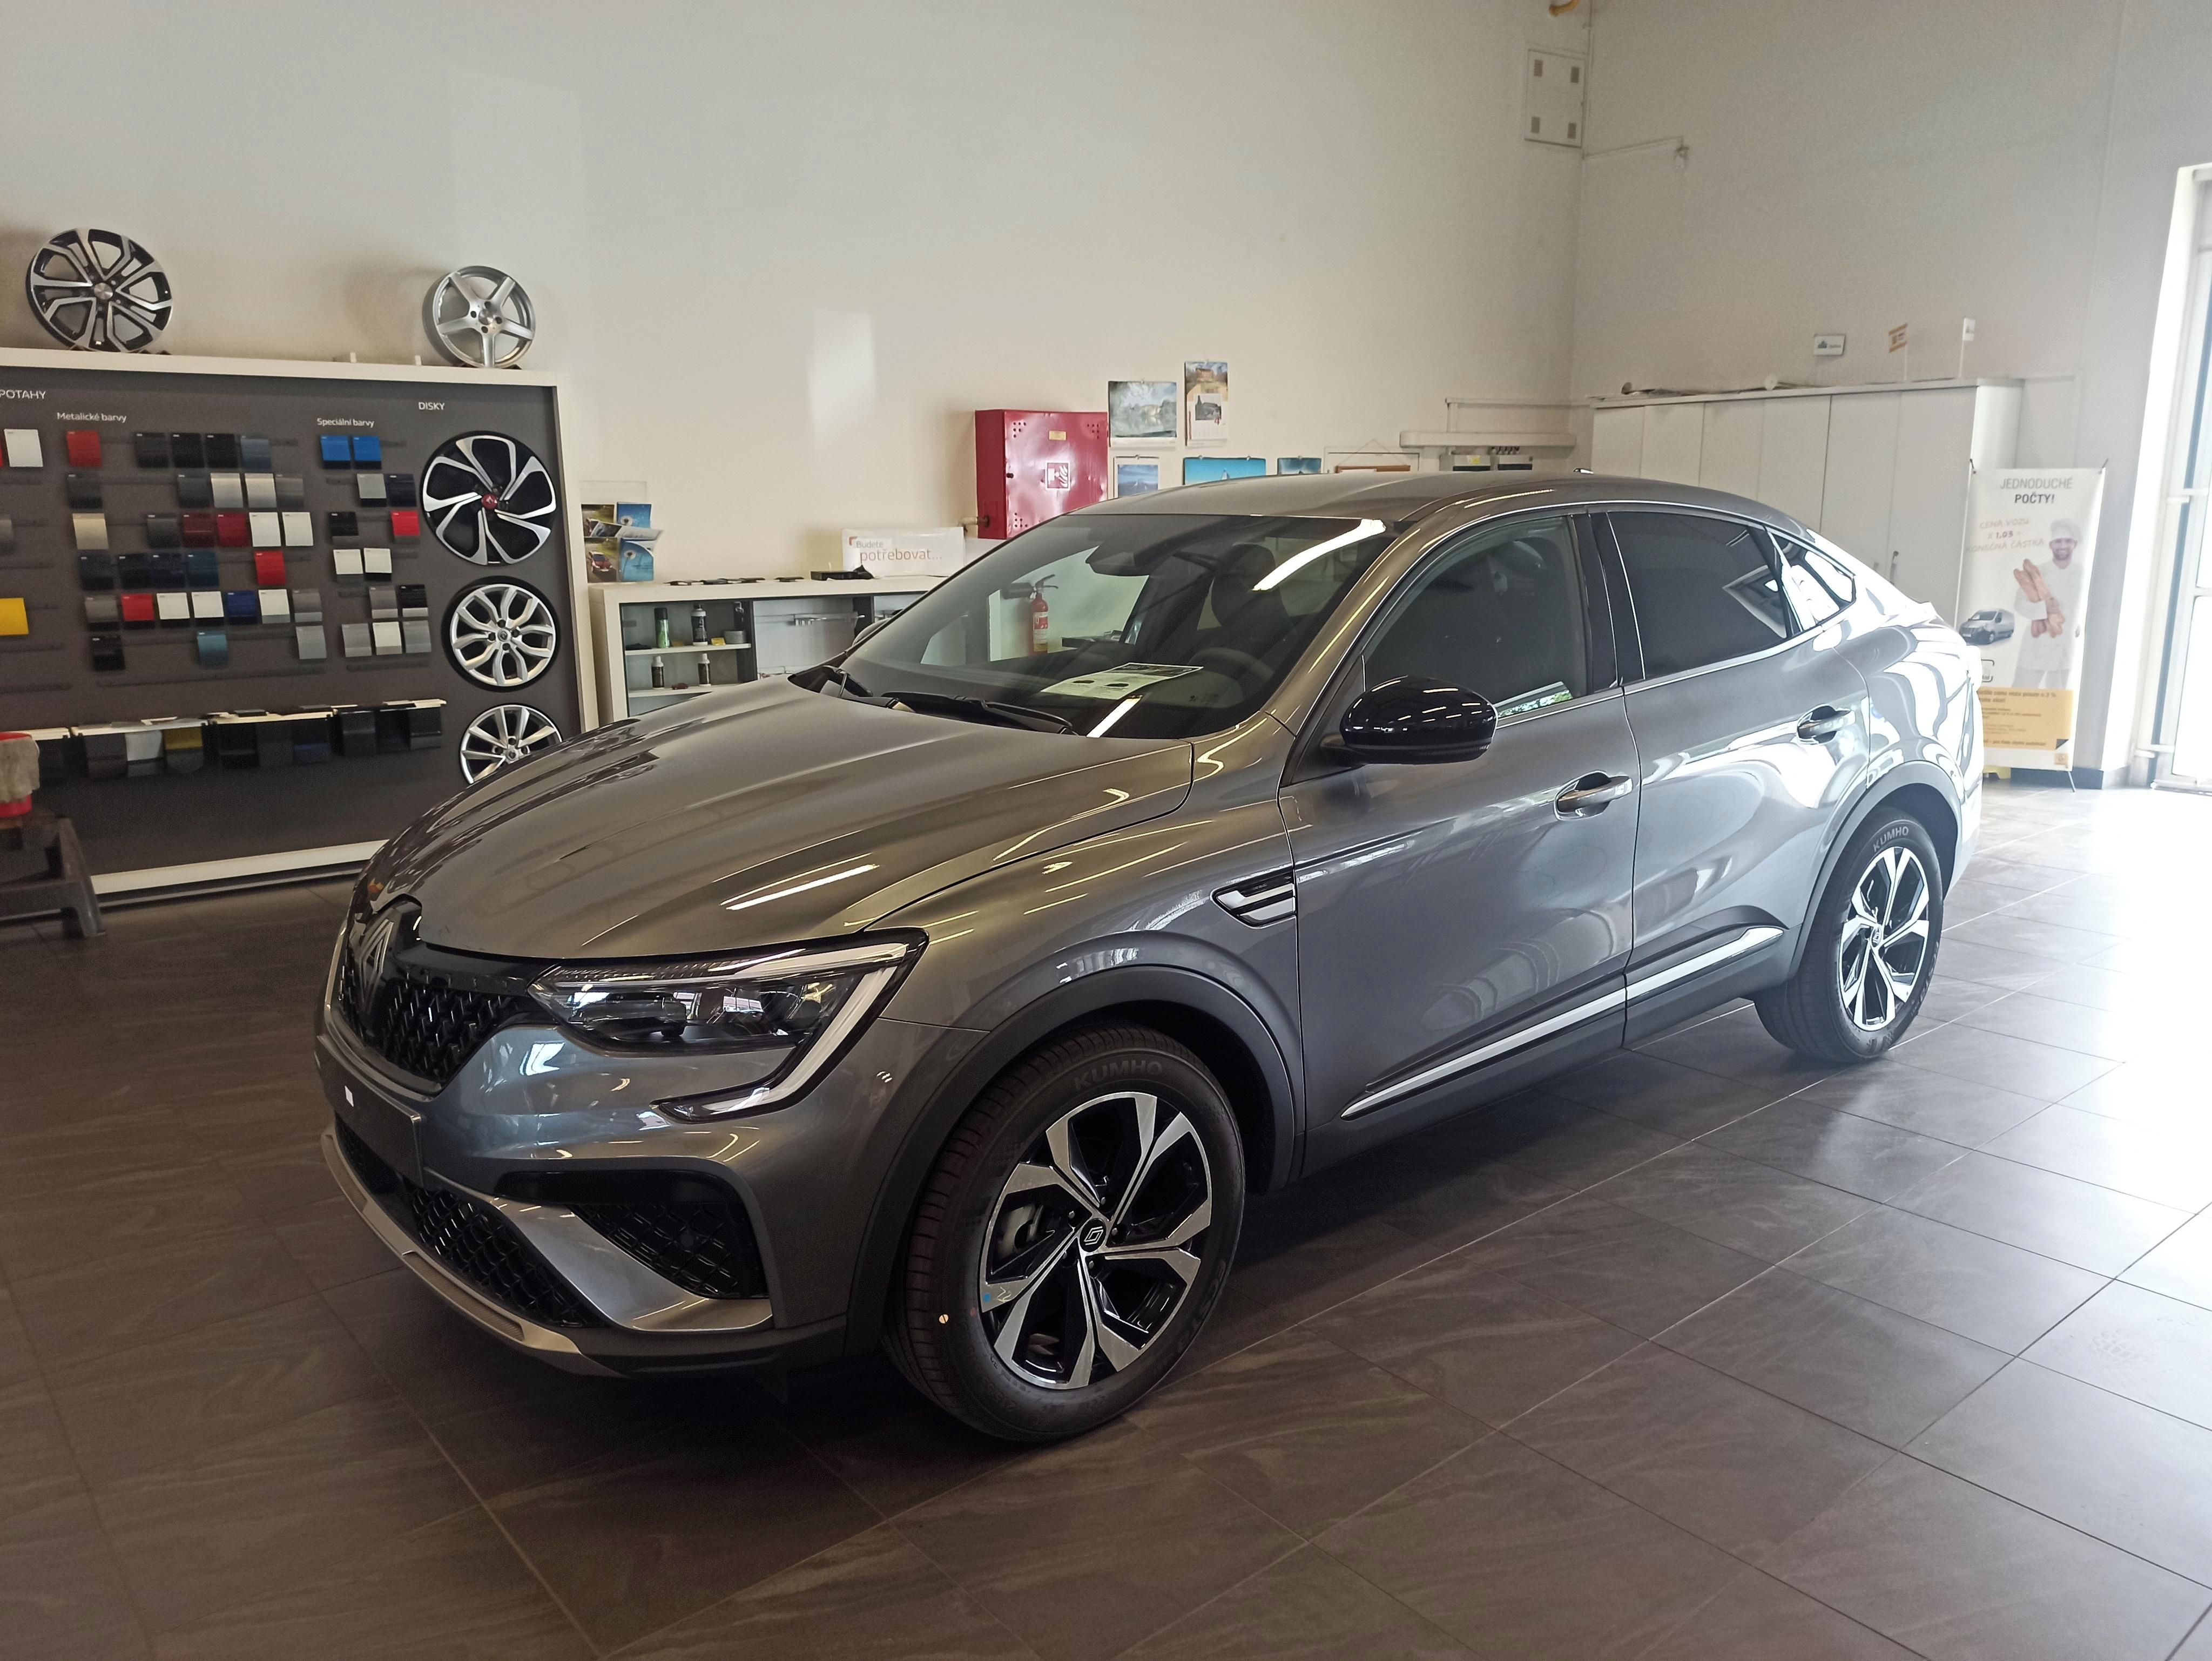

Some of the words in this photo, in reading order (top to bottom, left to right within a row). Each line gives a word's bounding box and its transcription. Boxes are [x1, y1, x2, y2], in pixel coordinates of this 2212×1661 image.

[418, 402, 445, 410] DISKY
[57, 412, 100, 421] Metalické
[101, 413, 127, 423] barvy
[316, 418, 352, 427] Speciální
[353, 419, 375, 428] barvy
[2000, 477, 2074, 490] JEDNODUCHÉ
[2014, 492, 2055, 504] POČTY!
[1995, 530, 2014, 539] 1.03
[856, 540, 884, 549] Budete
[1872, 826, 1910, 852] KUMHO
[1073, 1059, 1164, 1092] KUMHO
